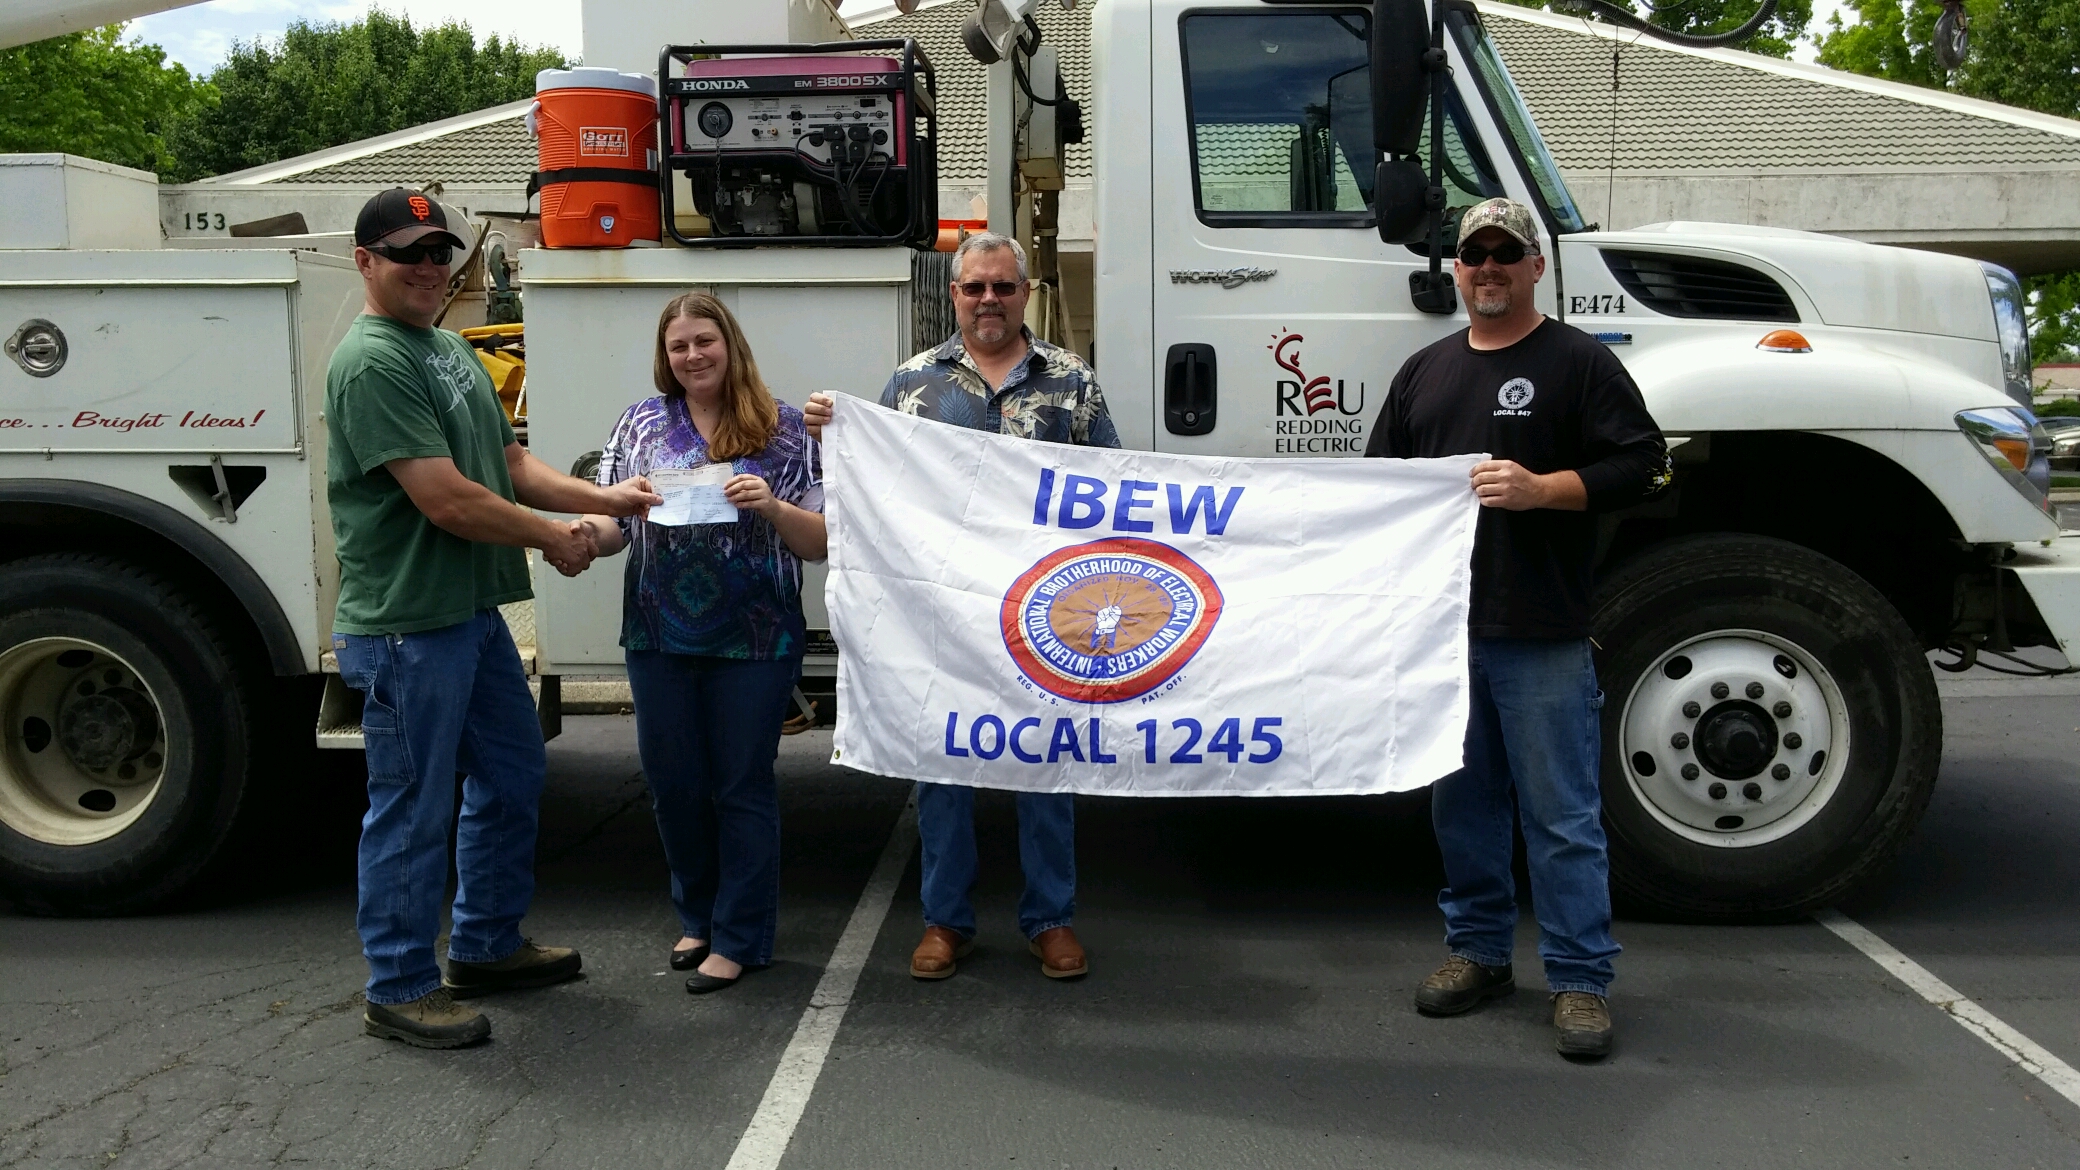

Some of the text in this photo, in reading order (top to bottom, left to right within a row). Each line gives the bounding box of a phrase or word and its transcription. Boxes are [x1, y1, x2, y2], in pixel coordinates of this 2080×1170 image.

[681, 80, 750, 91] HONDA
[794, 75, 888, 88] EM 3800SX
[1482, 206, 1506, 215] REU
[184, 212, 226, 230] 153
[1570, 294, 1626, 314] E474
[1276, 376, 1364, 417] REU
[71, 411, 173, 432] Bright
[179, 409, 266, 428] Ideas!
[1276, 419, 1362, 434] REDDING
[1275, 437, 1362, 453] ELECTRIC
[1032, 467, 1245, 536] IBEW
[1039, 559, 1143, 597] BROTHERHOOD
[1143, 567, 1166, 580] OF
[1107, 627, 1181, 675] WORKERS
[1016, 675, 1033, 693] REG.
[1141, 691, 1164, 705] PAT.
[1166, 675, 1187, 690] OFF.
[945, 711, 1283, 764] LOCAL 1245
